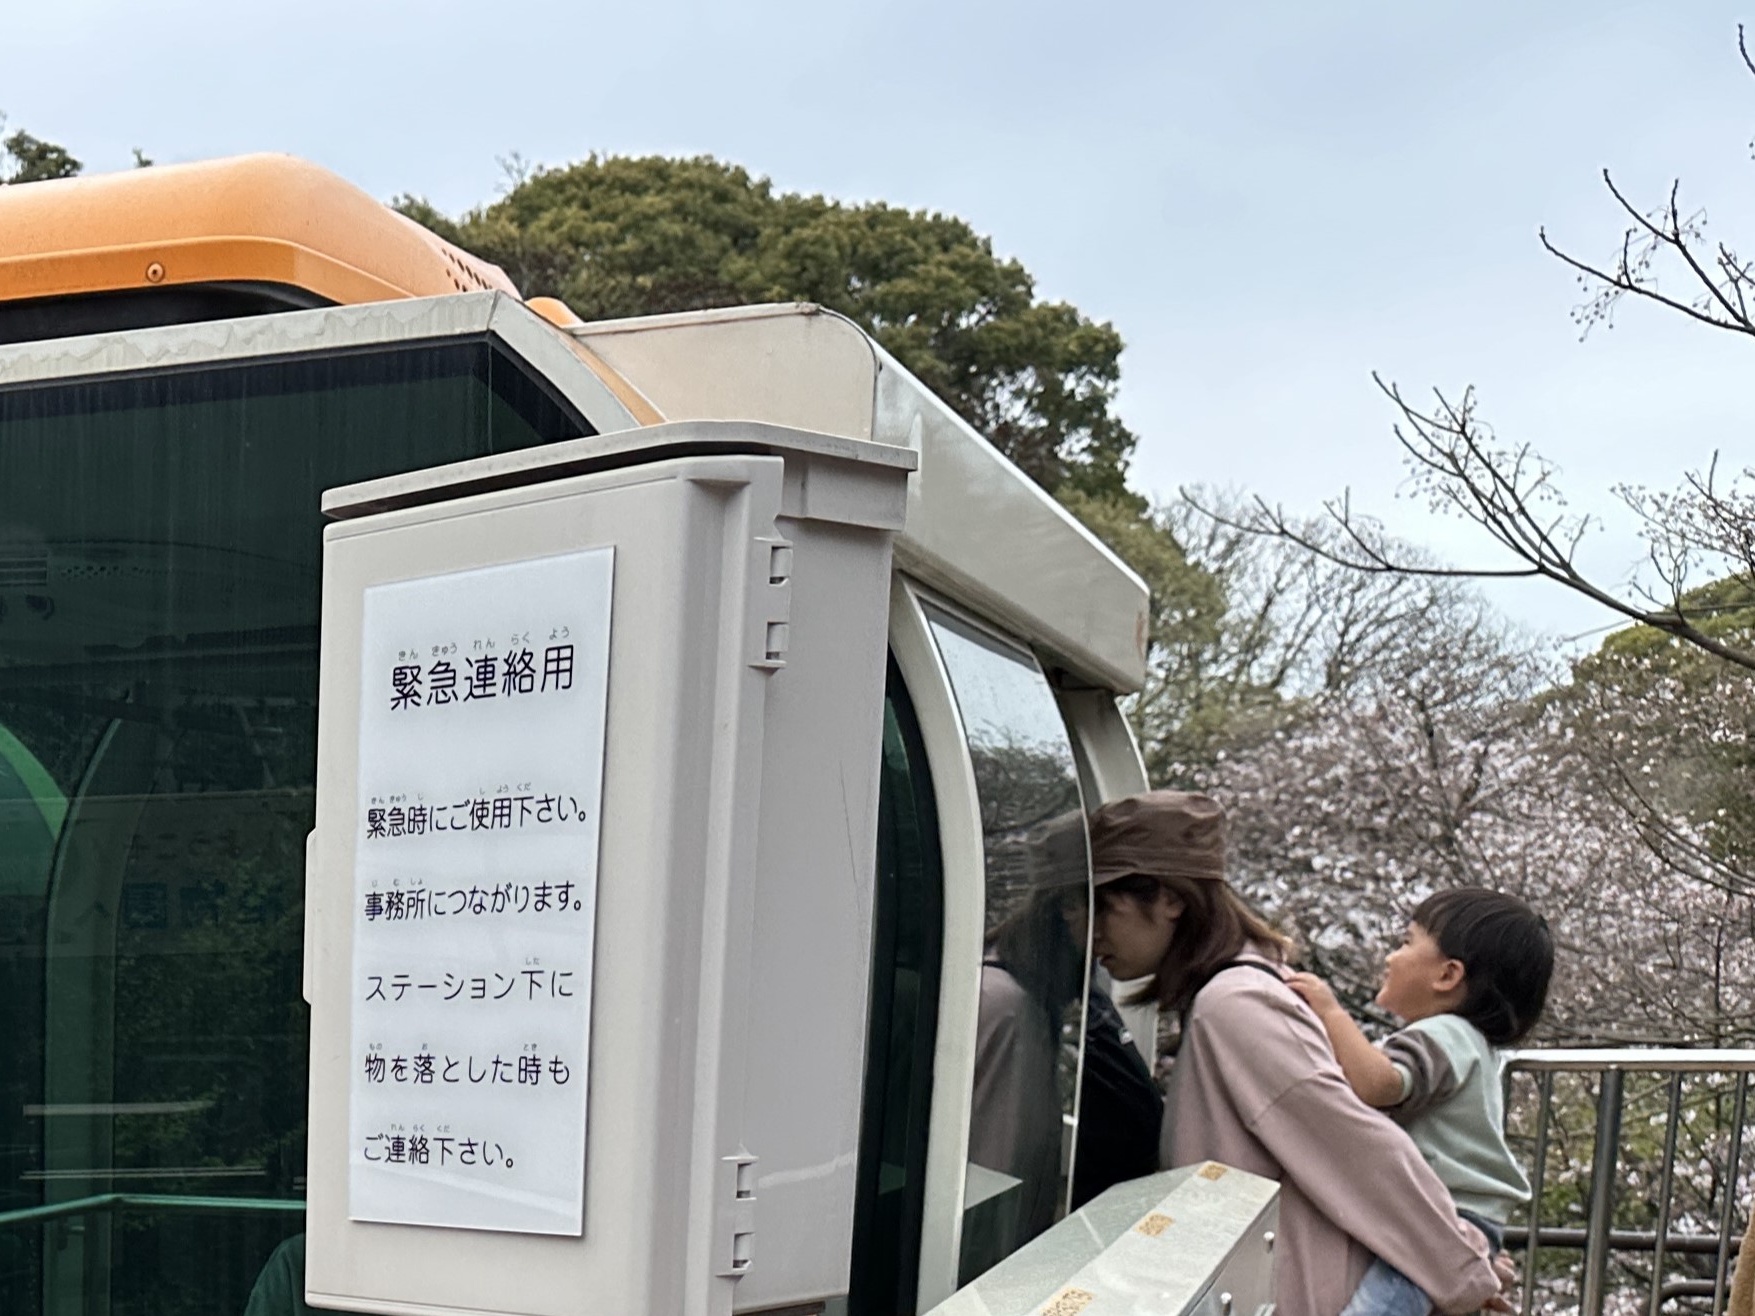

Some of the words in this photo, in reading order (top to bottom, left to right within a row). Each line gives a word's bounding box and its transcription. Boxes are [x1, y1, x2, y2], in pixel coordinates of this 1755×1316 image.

[390, 644, 574, 711] 緊急連絡用
[367, 793, 586, 839] 緊急時にご使用下さい。
[364, 880, 581, 921] 事務所につながります。
[366, 970, 573, 1001] ステーション下に
[365, 1053, 569, 1086] 物を落とした時も
[364, 1133, 513, 1168] ご連絡下さい。
